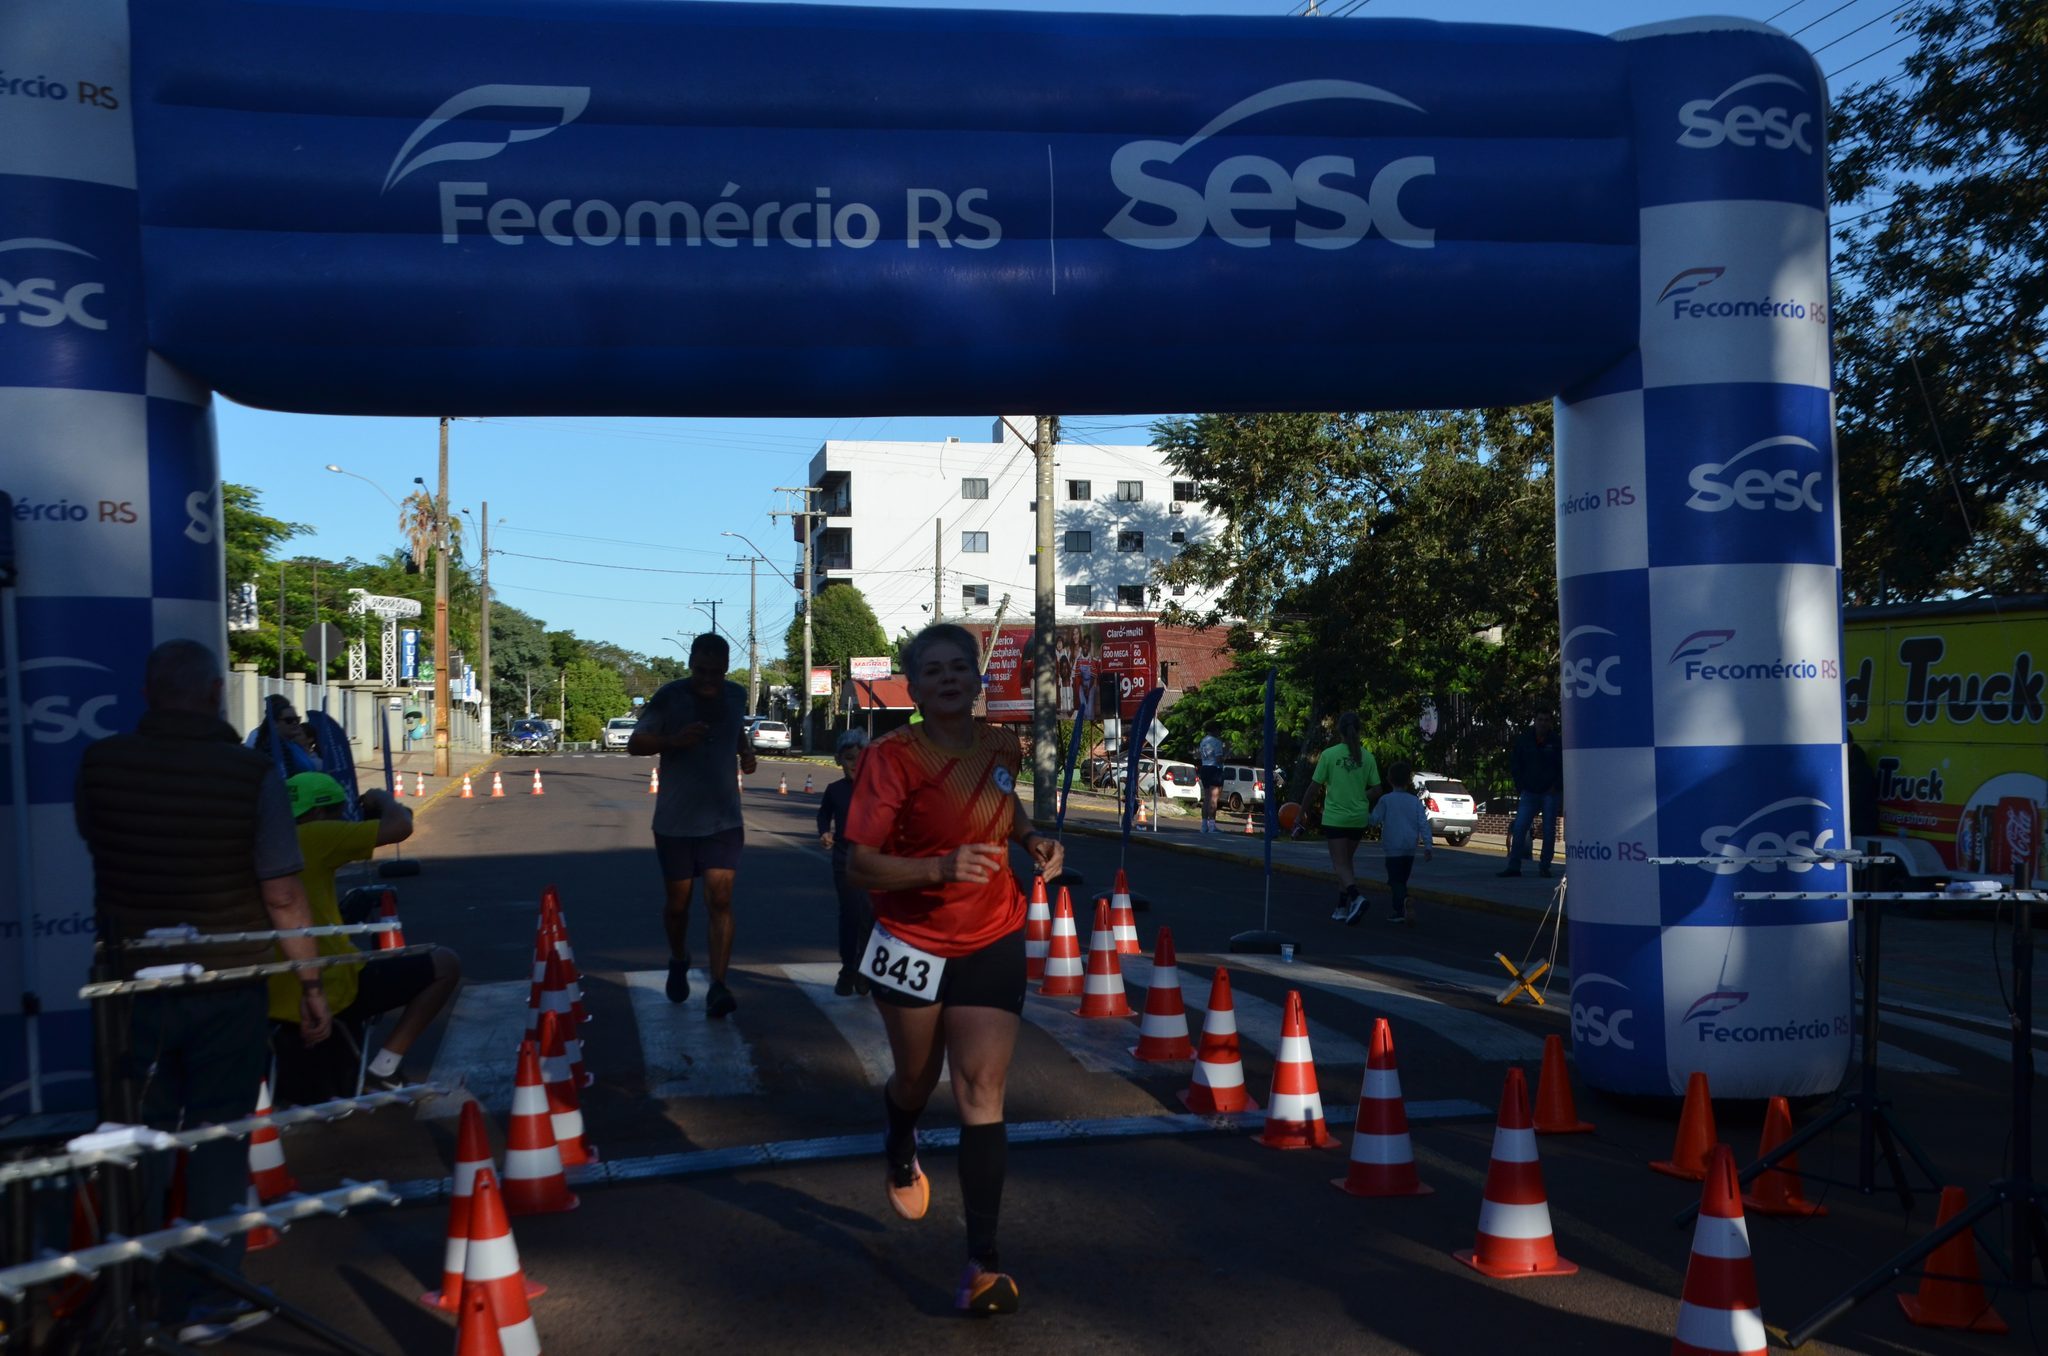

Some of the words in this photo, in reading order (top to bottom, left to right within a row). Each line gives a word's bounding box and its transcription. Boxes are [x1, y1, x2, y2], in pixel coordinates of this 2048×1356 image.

[78, 81, 119, 110] RS
[1676, 99, 1813, 155] Sesc
[1102, 139, 1437, 250] Sesc
[439, 181, 880, 249] Fecomércio
[906, 188, 1002, 250] RS
[1674, 297, 1805, 321] Fecomércio
[1810, 302, 1826, 324] RS
[1606, 485, 1636, 508] RS
[1686, 463, 1823, 513] Sesc
[98, 501, 138, 524] RS
[1685, 658, 1817, 681] Fecomércio
[1821, 659, 1838, 680] RS
[1900, 637, 2046, 725] Truck
[1120, 677, 1145, 698] 9,90
[1879, 758, 1944, 801] Truck
[1618, 841, 1647, 861] RS
[872, 945, 930, 991] 843
[1699, 1020, 1829, 1043] Fecomércio
[1834, 1015, 1849, 1038] RS
